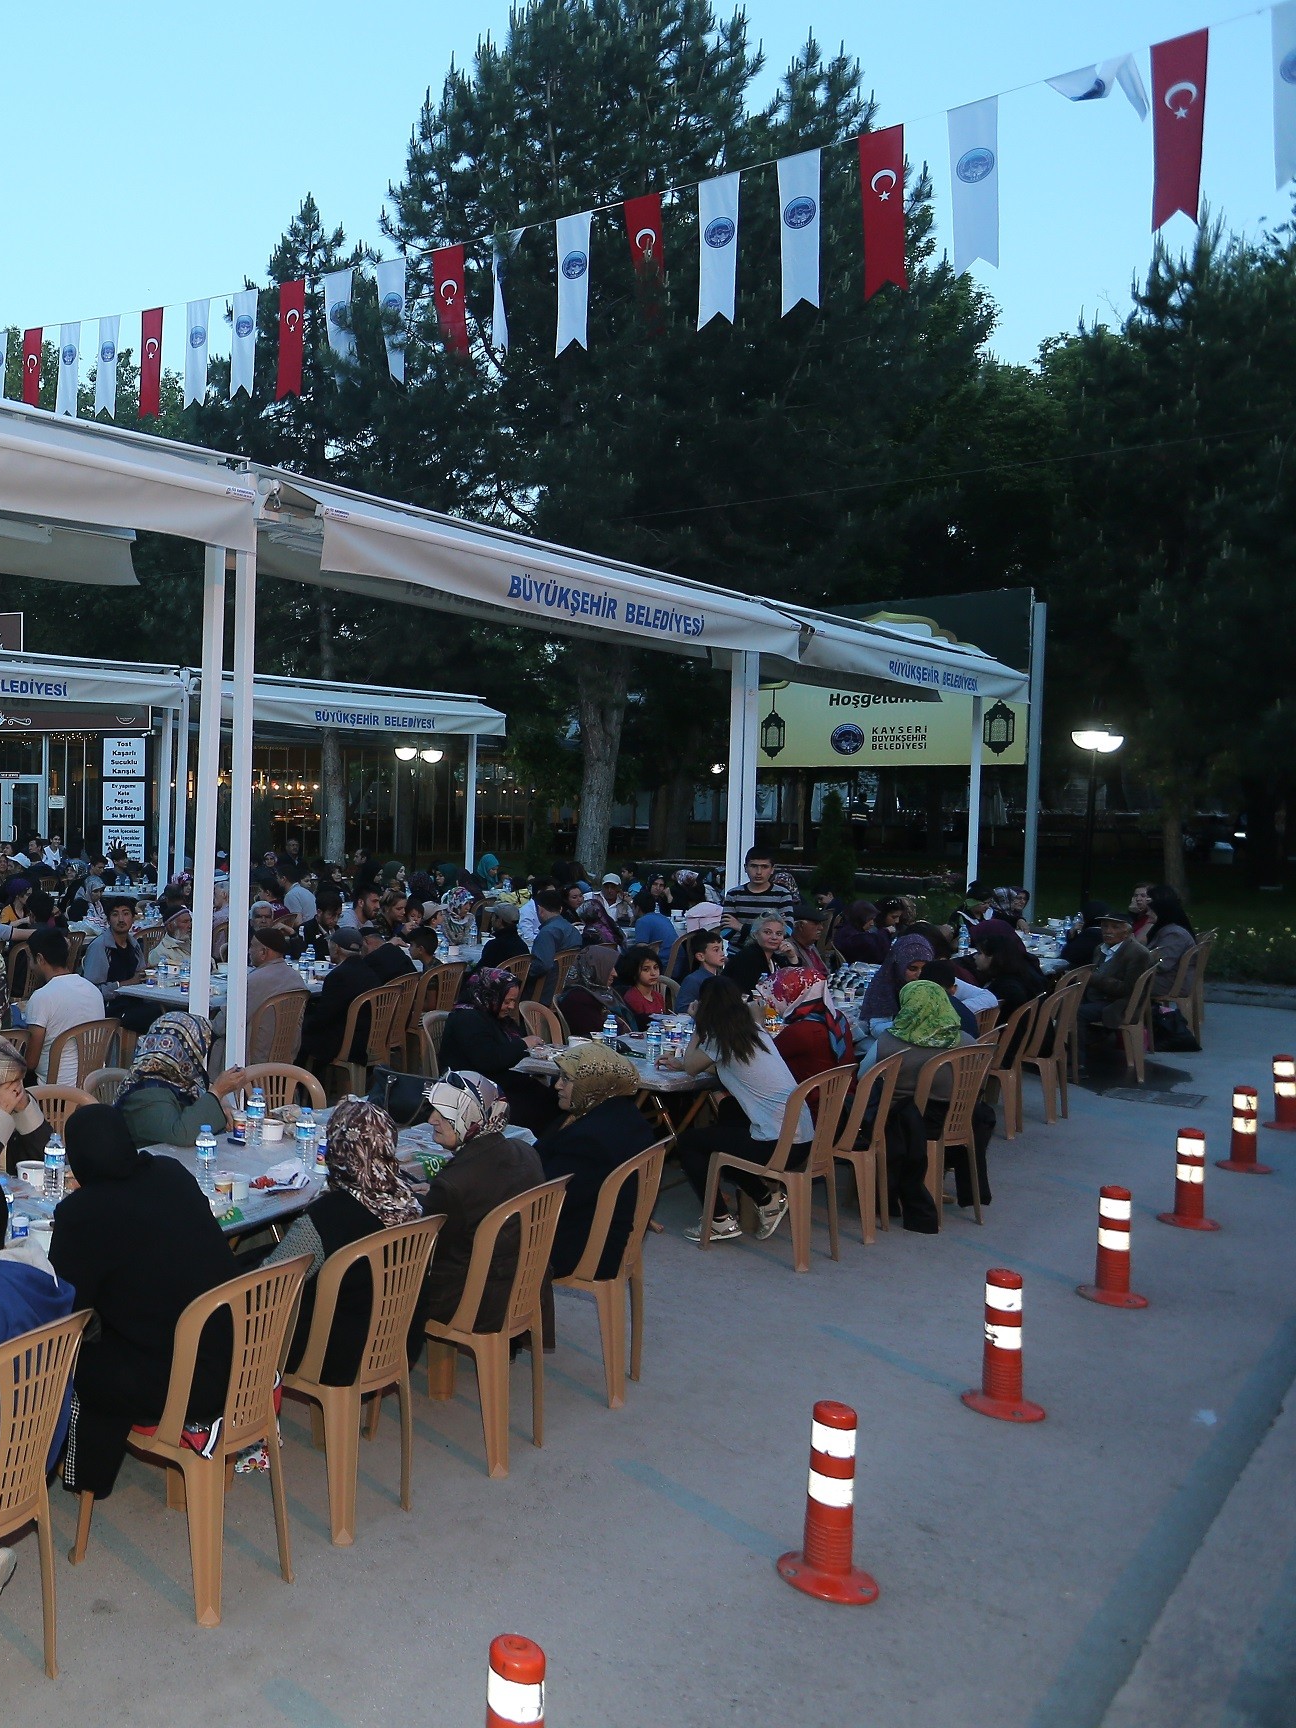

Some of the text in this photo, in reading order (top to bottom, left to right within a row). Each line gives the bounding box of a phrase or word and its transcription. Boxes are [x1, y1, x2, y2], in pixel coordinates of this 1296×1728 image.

[507, 574, 618, 619] BÜYÜKŞEHİR
[625, 602, 705, 637] BELEDİYESİ
[889, 659, 979, 692] BÜYÜKŞEHİR BELEDİYESİ
[315, 708, 435, 729] BÜYÜKŞEHİR BELEDİYESİ
[872, 725, 928, 735] KAYSERİ
[871, 734, 927, 743] BÜYÜKŞEHİR
[871, 742, 927, 750] BELEDİYESİ
